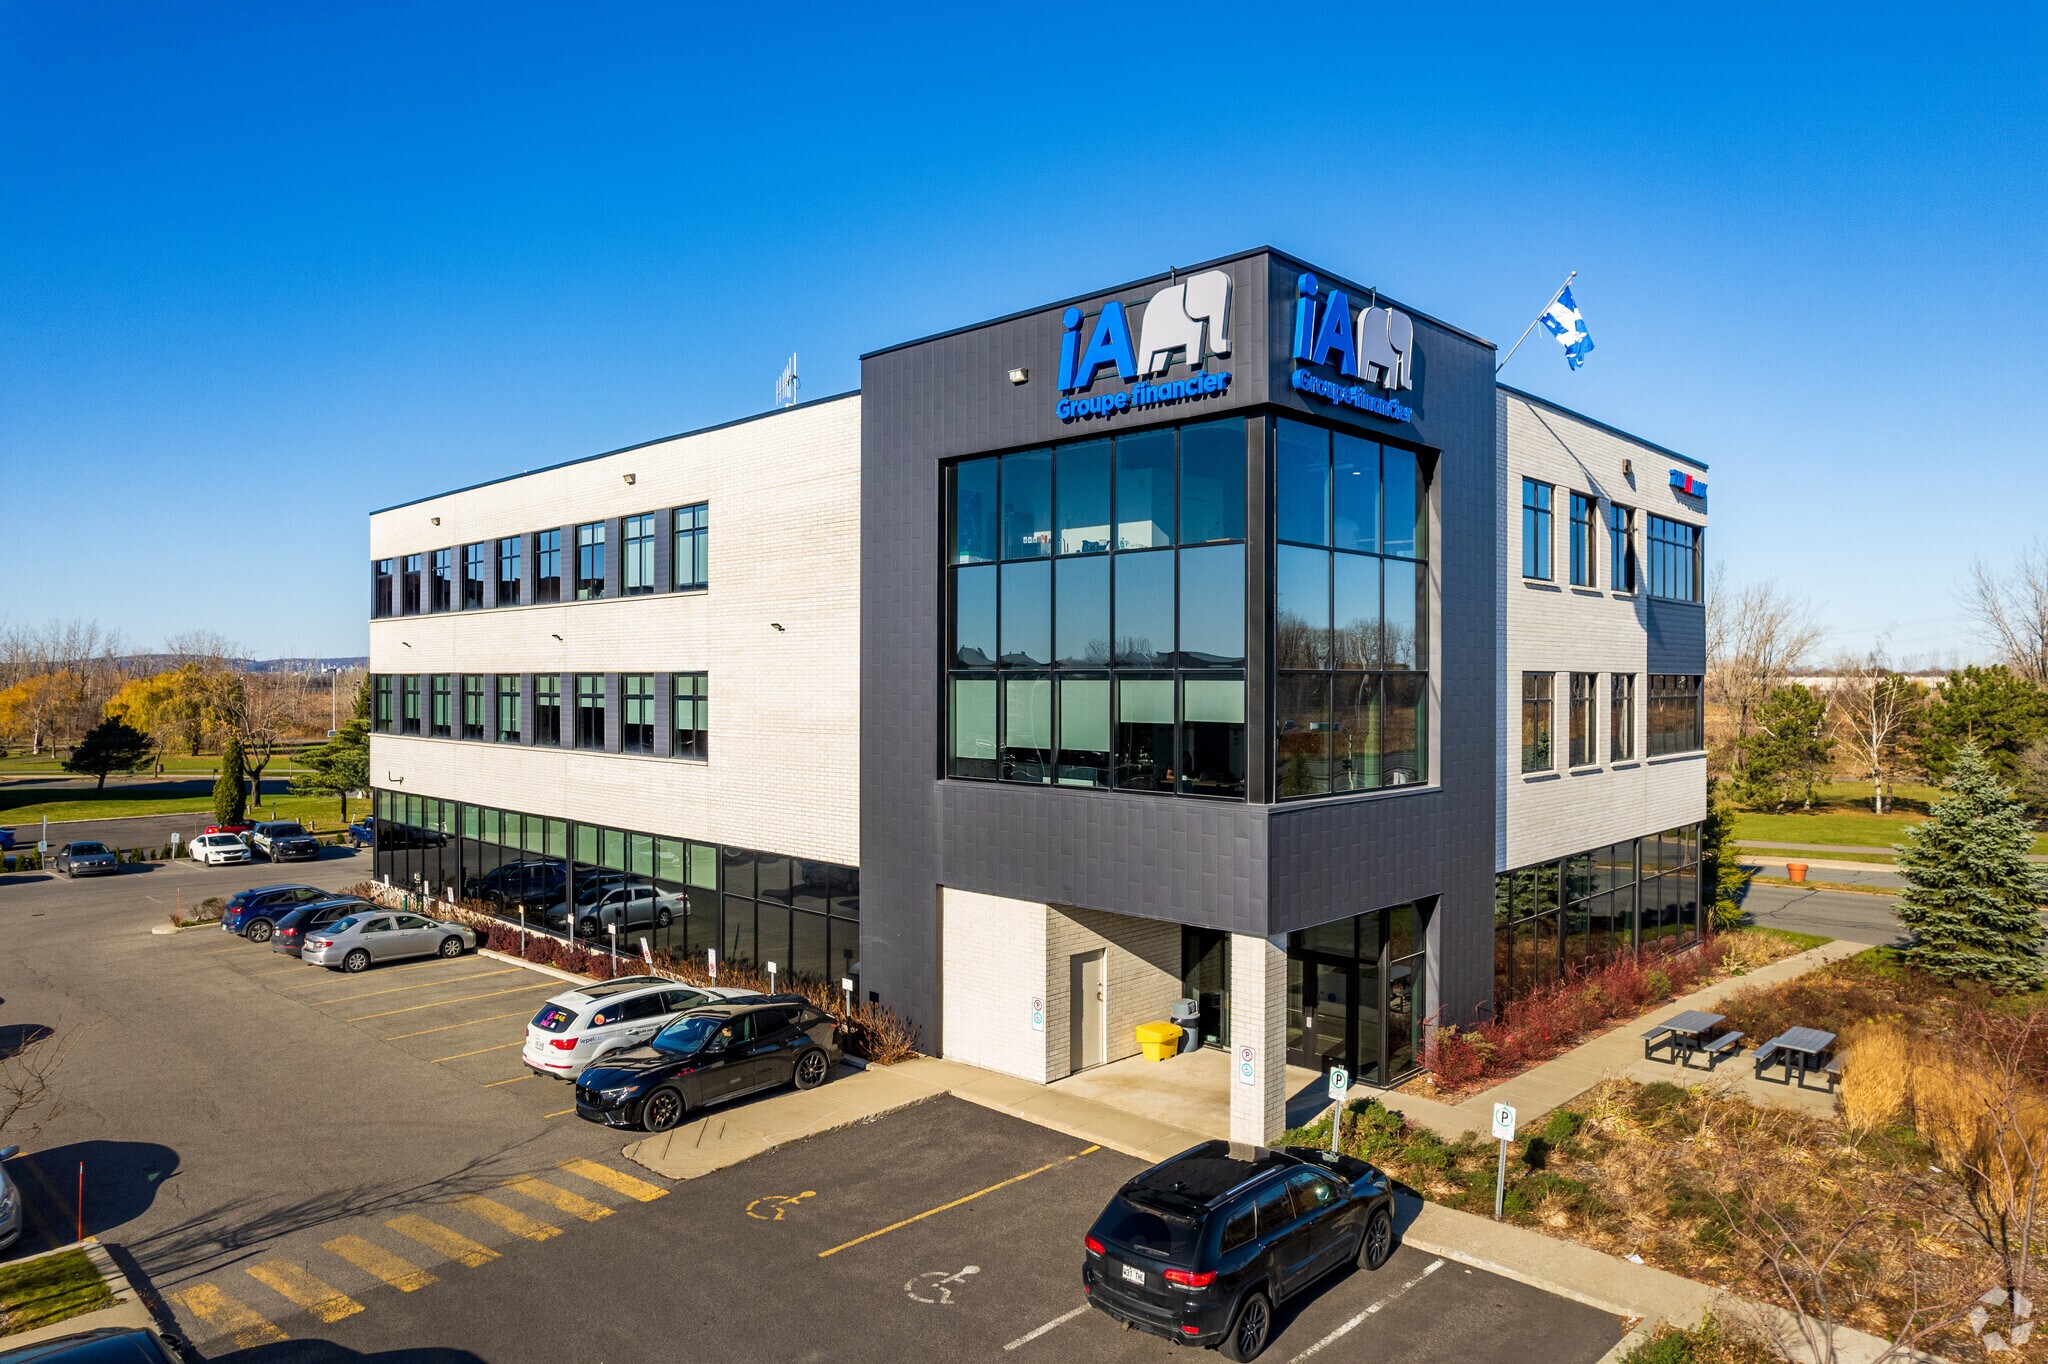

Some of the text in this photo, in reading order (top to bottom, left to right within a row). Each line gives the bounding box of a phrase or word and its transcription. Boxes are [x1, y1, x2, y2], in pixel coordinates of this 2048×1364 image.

[1057, 301, 1139, 391] iA
[1293, 272, 1358, 376] iA
[1056, 371, 1232, 419] Groupe financier
[1292, 368, 1412, 422] Groupe financier
[1336, 1074, 1343, 1085] P
[1501, 1111, 1508, 1123] P
